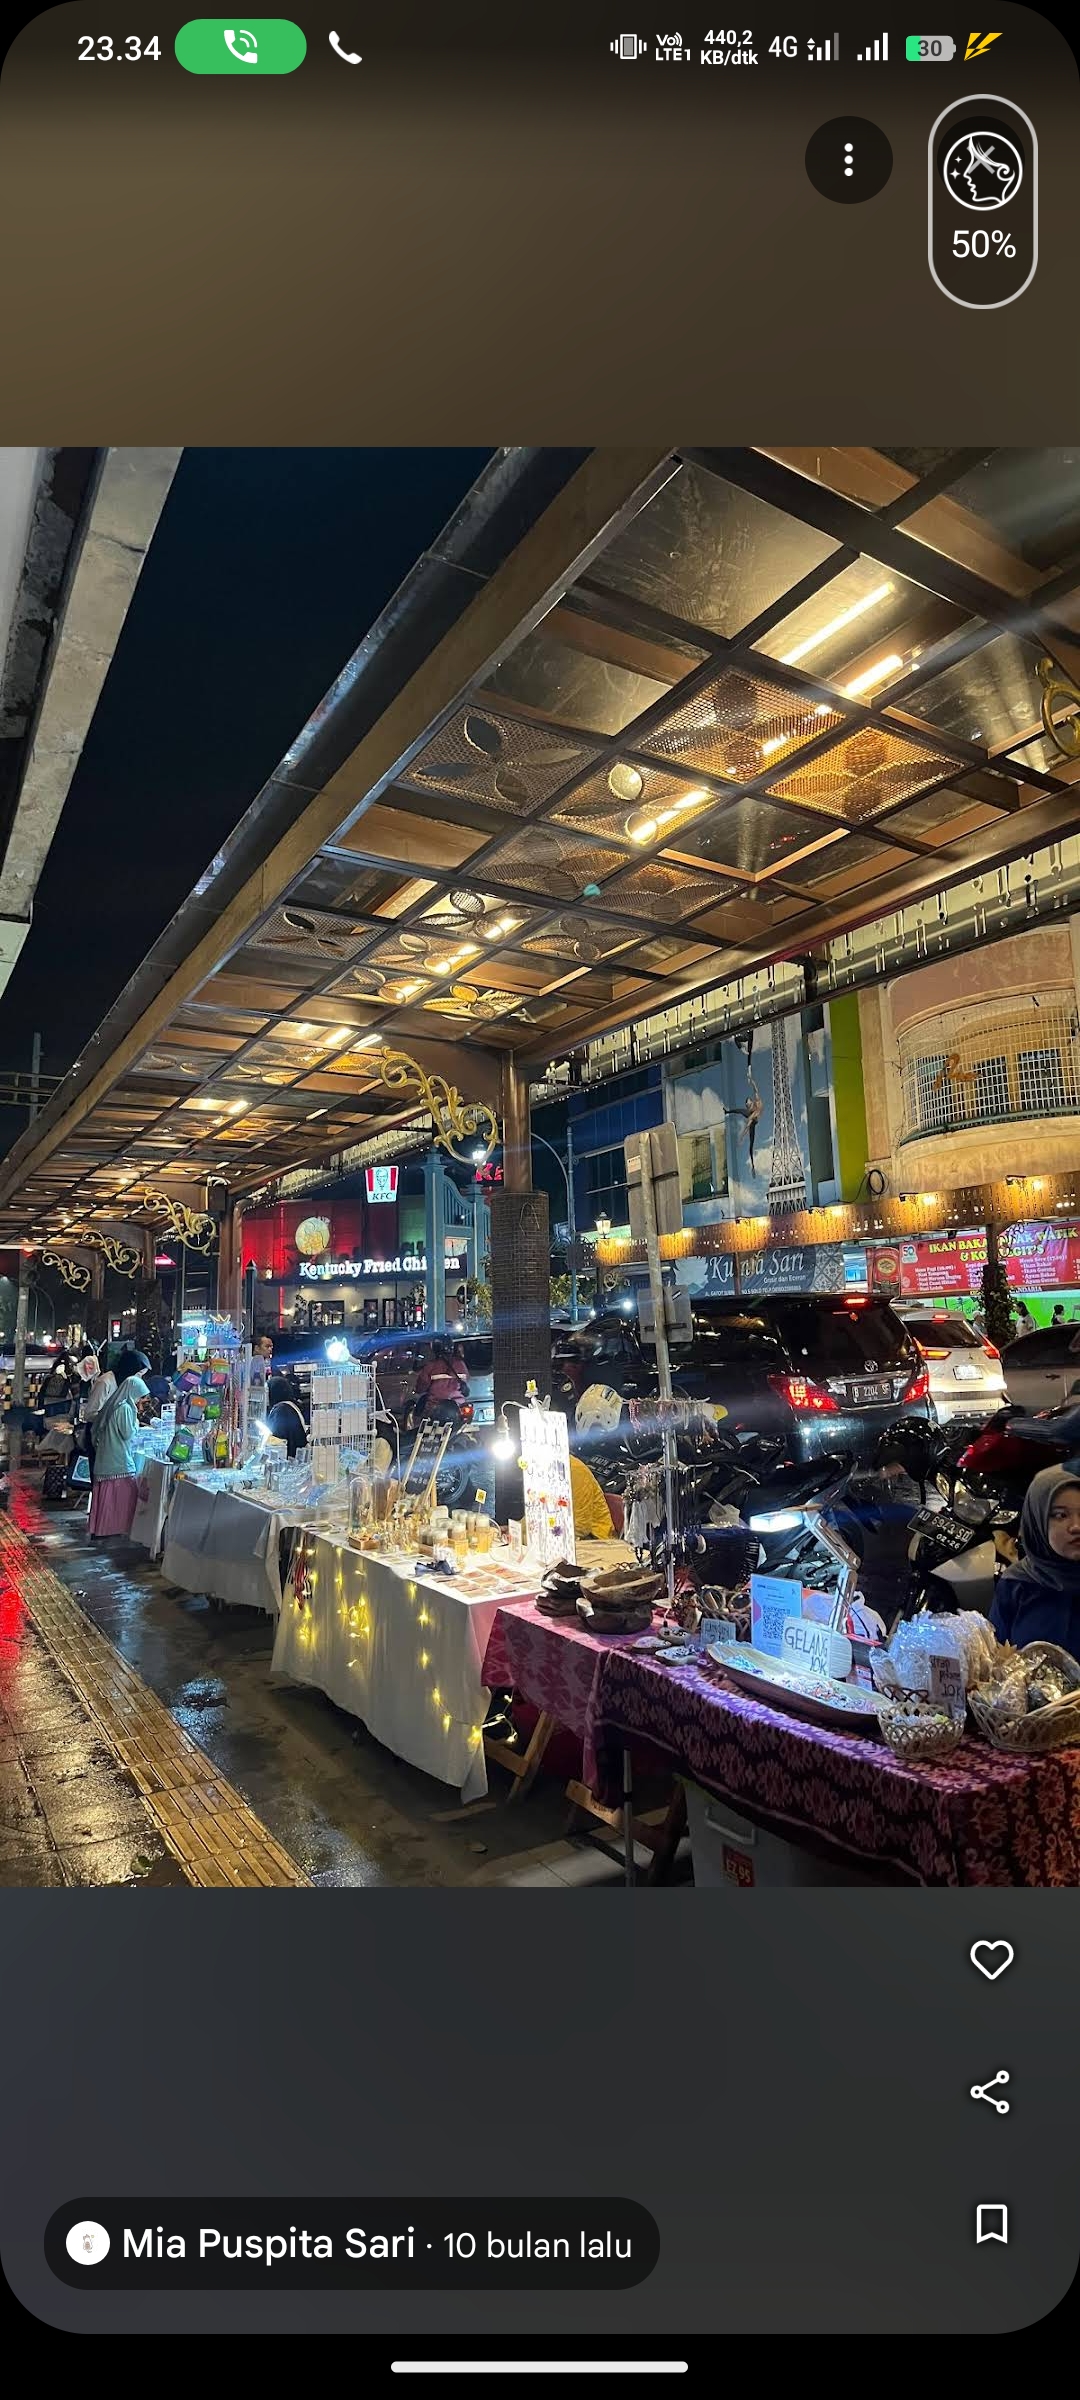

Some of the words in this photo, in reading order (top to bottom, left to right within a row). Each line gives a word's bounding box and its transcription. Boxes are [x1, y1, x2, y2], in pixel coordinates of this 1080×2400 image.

[372, 1192, 393, 1200] KFC
[929, 1241, 956, 1254] IKAN
[958, 1237, 987, 1250] BAKA
[1036, 1227, 1079, 1241] WATIK
[299, 1260, 363, 1280] Kentucky
[363, 1257, 401, 1274] Fried
[402, 1255, 460, 1272] Chien
[769, 1248, 804, 1276] Sari
[863, 1384, 879, 1396] 2204
[918, 1510, 931, 1521] AD
[785, 1626, 828, 1658] GELANG
